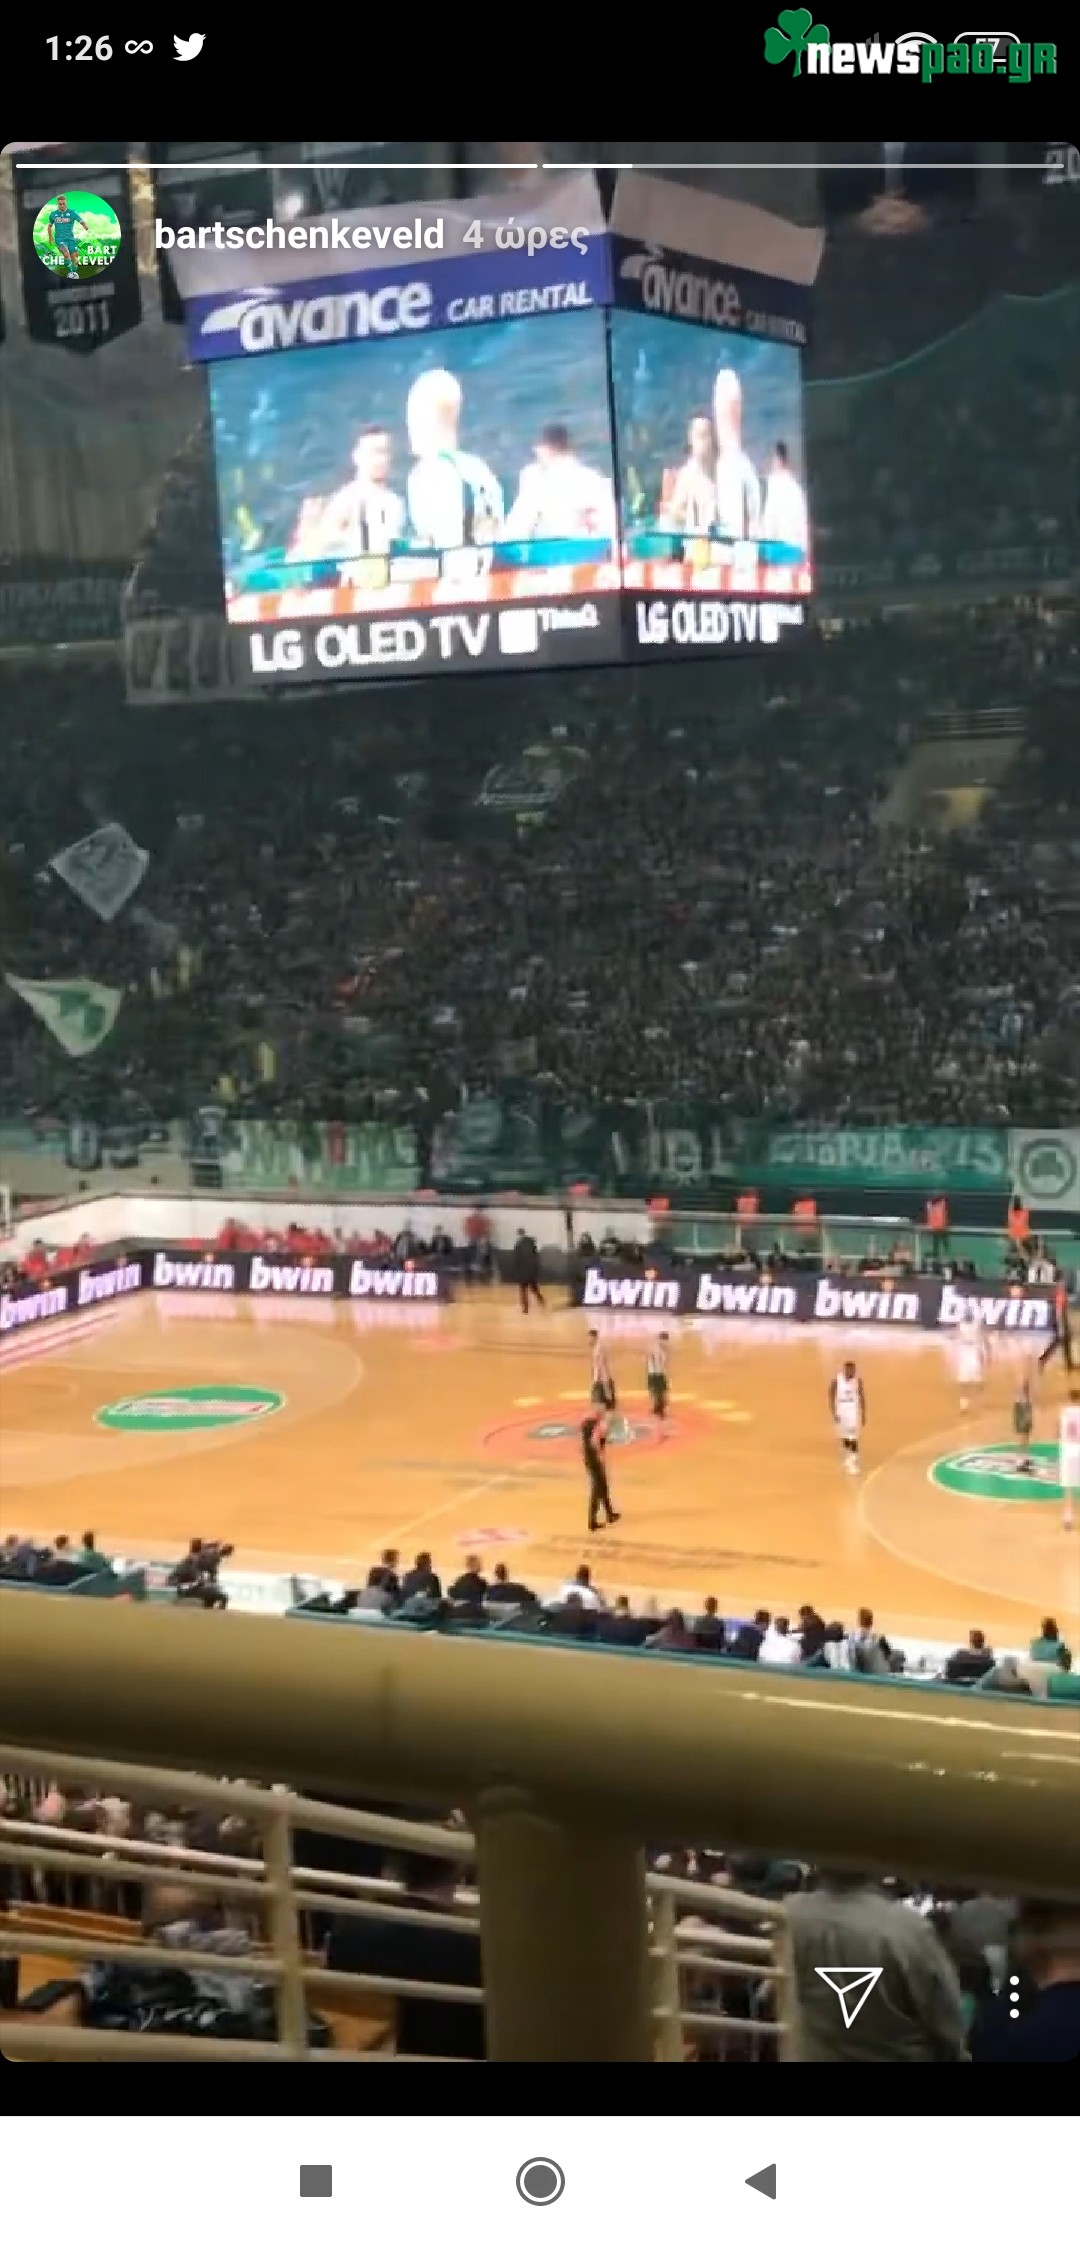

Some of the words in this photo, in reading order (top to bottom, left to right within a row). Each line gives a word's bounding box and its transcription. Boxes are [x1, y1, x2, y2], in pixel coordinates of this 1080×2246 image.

[240, 282, 432, 352] avance
[446, 297, 496, 324] CAR
[499, 281, 595, 318] RENTAL
[250, 629, 304, 674] LG
[315, 620, 425, 668] OLED
[431, 613, 491, 658] TV
[636, 600, 670, 644] LG
[671, 601, 729, 643] OLED
[153, 1252, 235, 1289] bwin
[249, 1255, 334, 1292] bwin
[349, 1259, 438, 1296] bwin
[583, 1268, 681, 1308] bwin
[696, 1273, 797, 1314] bwin
[814, 1278, 919, 1319] bwin
